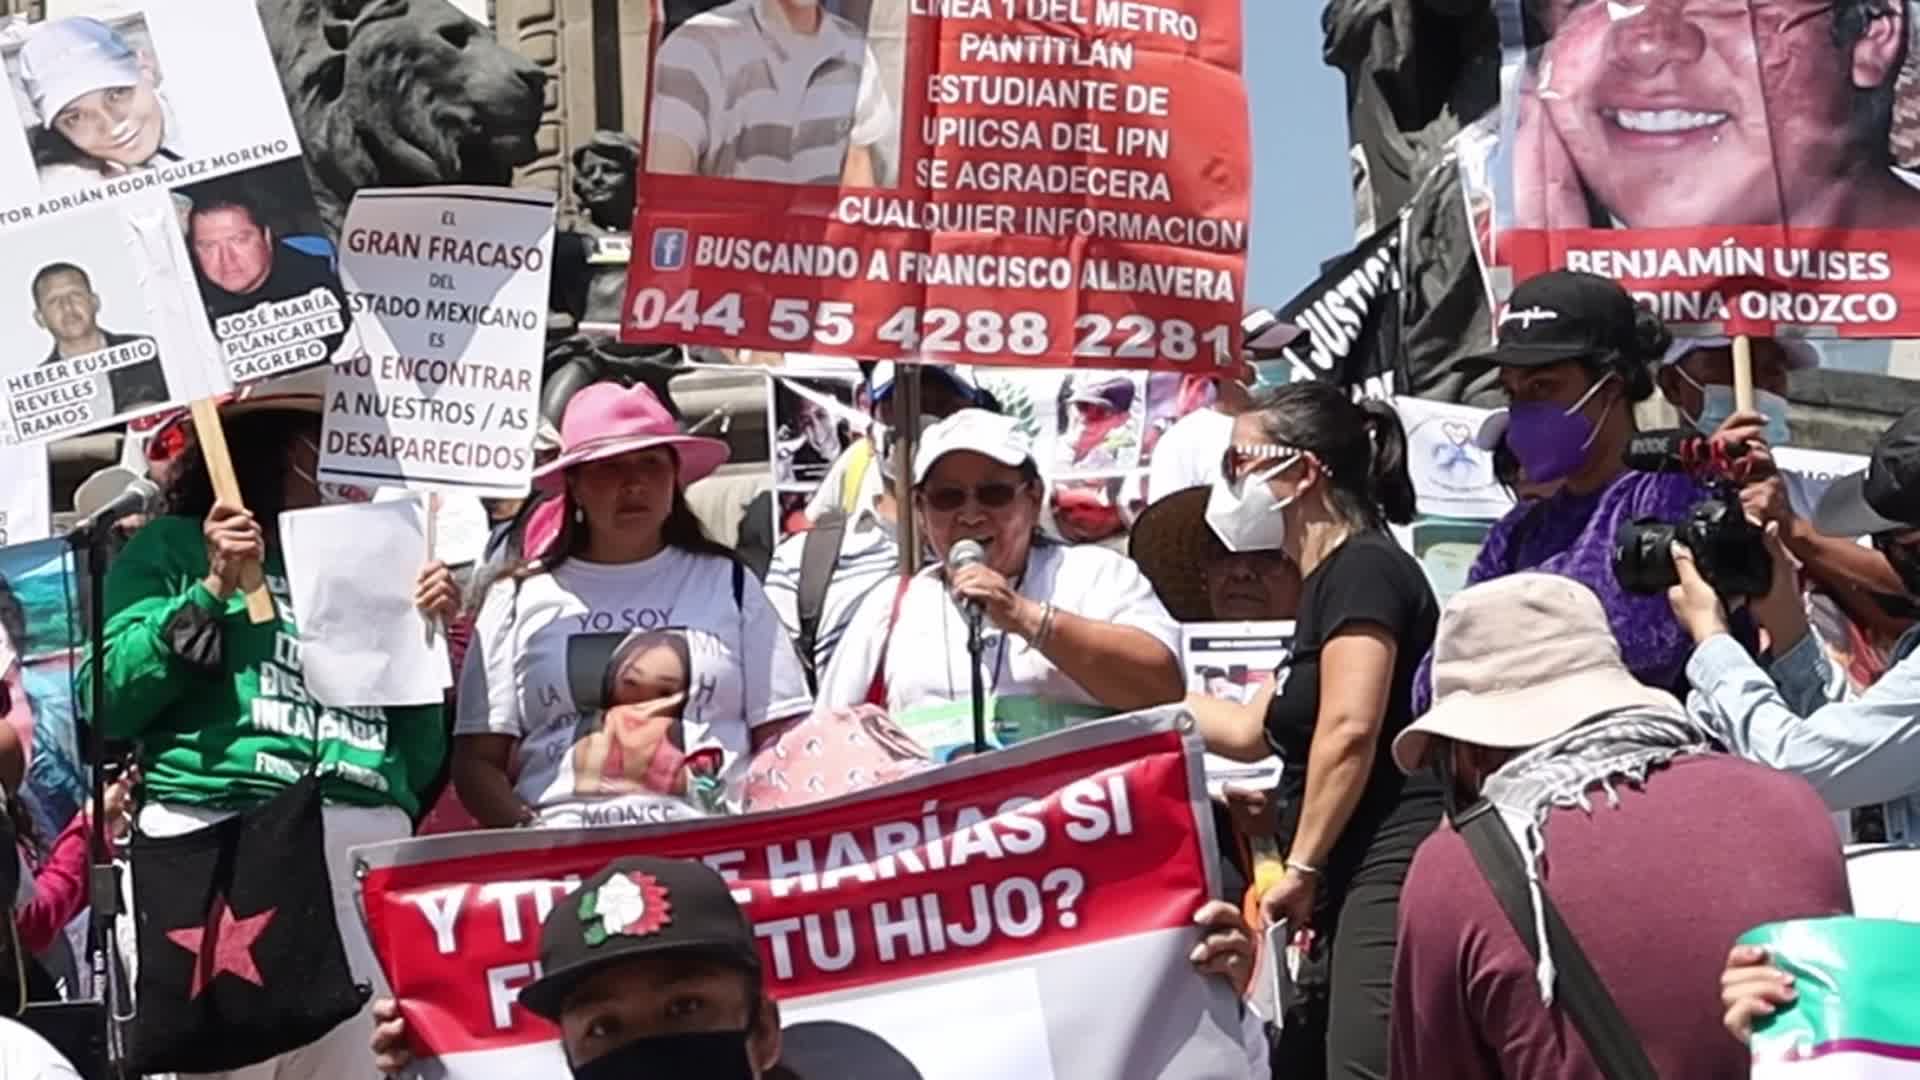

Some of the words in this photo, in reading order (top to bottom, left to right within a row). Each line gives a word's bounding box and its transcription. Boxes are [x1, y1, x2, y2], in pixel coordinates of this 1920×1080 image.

[1027, 0, 1088, 24] DEL
[1095, 1, 1197, 41] METRO
[928, 75, 1118, 110] ESTUDIANTE
[1126, 85, 1169, 116] DE
[923, 116, 1042, 150] UPIICSA
[1052, 123, 1105, 153] DEL
[1117, 127, 1169, 159] IPN
[38, 187, 102, 215] ADRIÁN
[108, 159, 208, 196] RODRÍGUEZ
[212, 139, 289, 169] MORENO
[916, 160, 948, 189] SE
[956, 162, 1171, 203] AGRADECERA
[442, 211, 456, 226] EL
[839, 195, 1015, 234] CUALQUIER
[1025, 206, 1244, 249] INFORMACION
[349, 229, 421, 260] GRAN
[428, 236, 543, 272] FRACASO
[695, 235, 858, 279] BUSCANDO
[866, 249, 889, 281] A
[899, 251, 1072, 290] FRANCISCO
[1081, 259, 1234, 303] ALBAVERA
[1567, 238, 1763, 279] BENJAMÍN
[1773, 250, 1890, 281] ULISES
[430, 274, 456, 290] DEL
[220, 308, 267, 336] JOSÉ
[274, 287, 334, 321] MARÍA
[344, 291, 420, 318] STADO
[426, 300, 537, 330] MEXICANO
[630, 287, 745, 336] 044
[768, 298, 855, 346] 55
[877, 305, 1048, 355] 4288
[1072, 312, 1233, 366] 2281
[1740, 290, 1898, 323] OROZCO
[226, 315, 338, 356] PLANCARTE
[430, 333, 445, 348] ES
[8, 364, 69, 392] HEBER
[74, 342, 154, 373] EUSEBIO
[233, 343, 322, 377] SAGRERO
[381, 355, 532, 392] ENCONTRAR
[15, 381, 94, 413] REVELES
[330, 392, 348, 414] A
[356, 394, 475, 425] NUESTROS
[499, 408, 528, 430] AS
[21, 407, 90, 436] RAMOS
[327, 430, 526, 470] DESAPARECIDOS
[578, 612, 613, 632] YO
[621, 607, 675, 630] SOY
[414, 882, 468, 955] Y
[765, 800, 1046, 898] HARÍAS
[1059, 775, 1133, 842] SI
[753, 909, 857, 980] TU
[872, 867, 1085, 962] HIJO?
